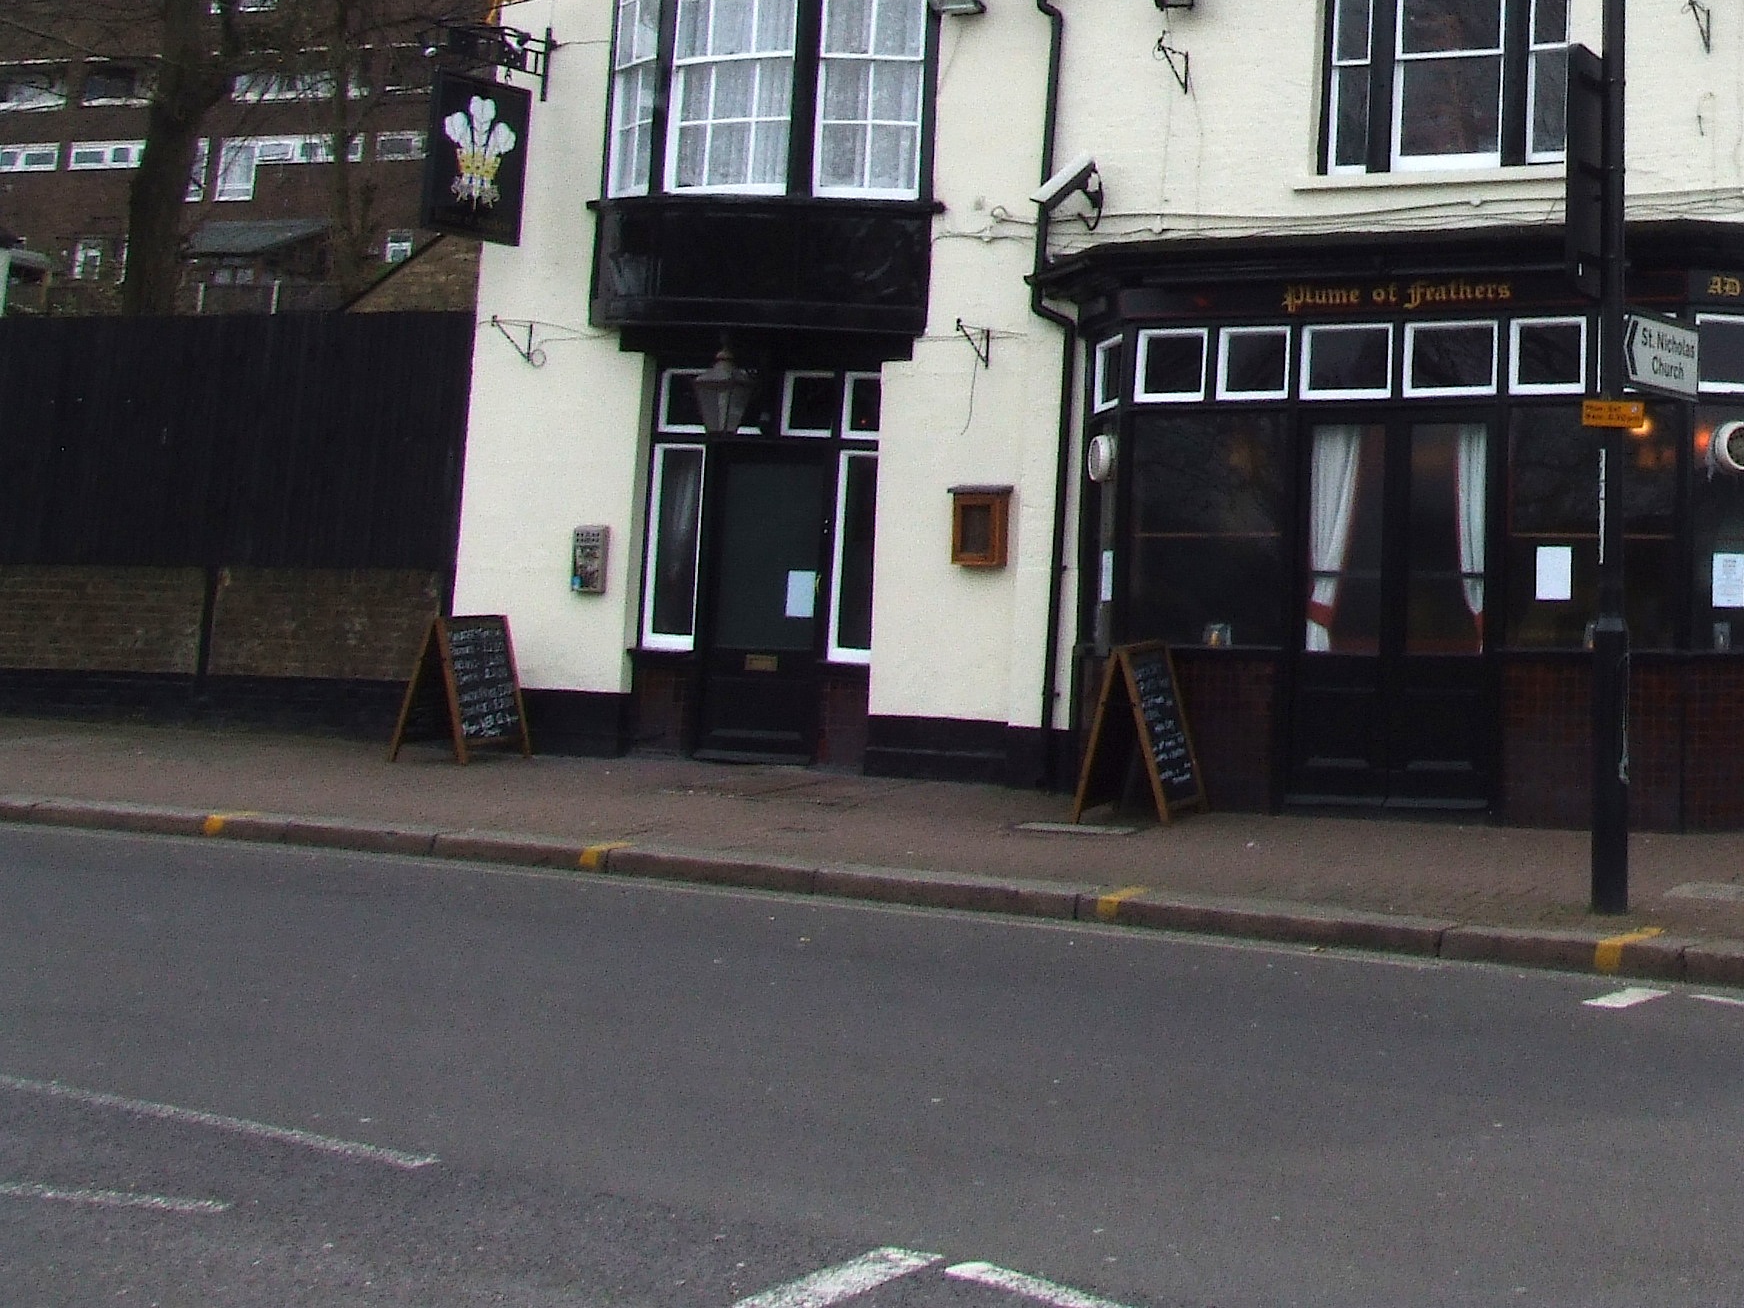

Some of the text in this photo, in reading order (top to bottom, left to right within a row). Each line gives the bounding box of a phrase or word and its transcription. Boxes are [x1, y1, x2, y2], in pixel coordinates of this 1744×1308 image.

[1282, 277, 1512, 313] Plume of Feathers
[1656, 331, 1696, 359] Nicholas
[1651, 355, 1685, 380] Church
